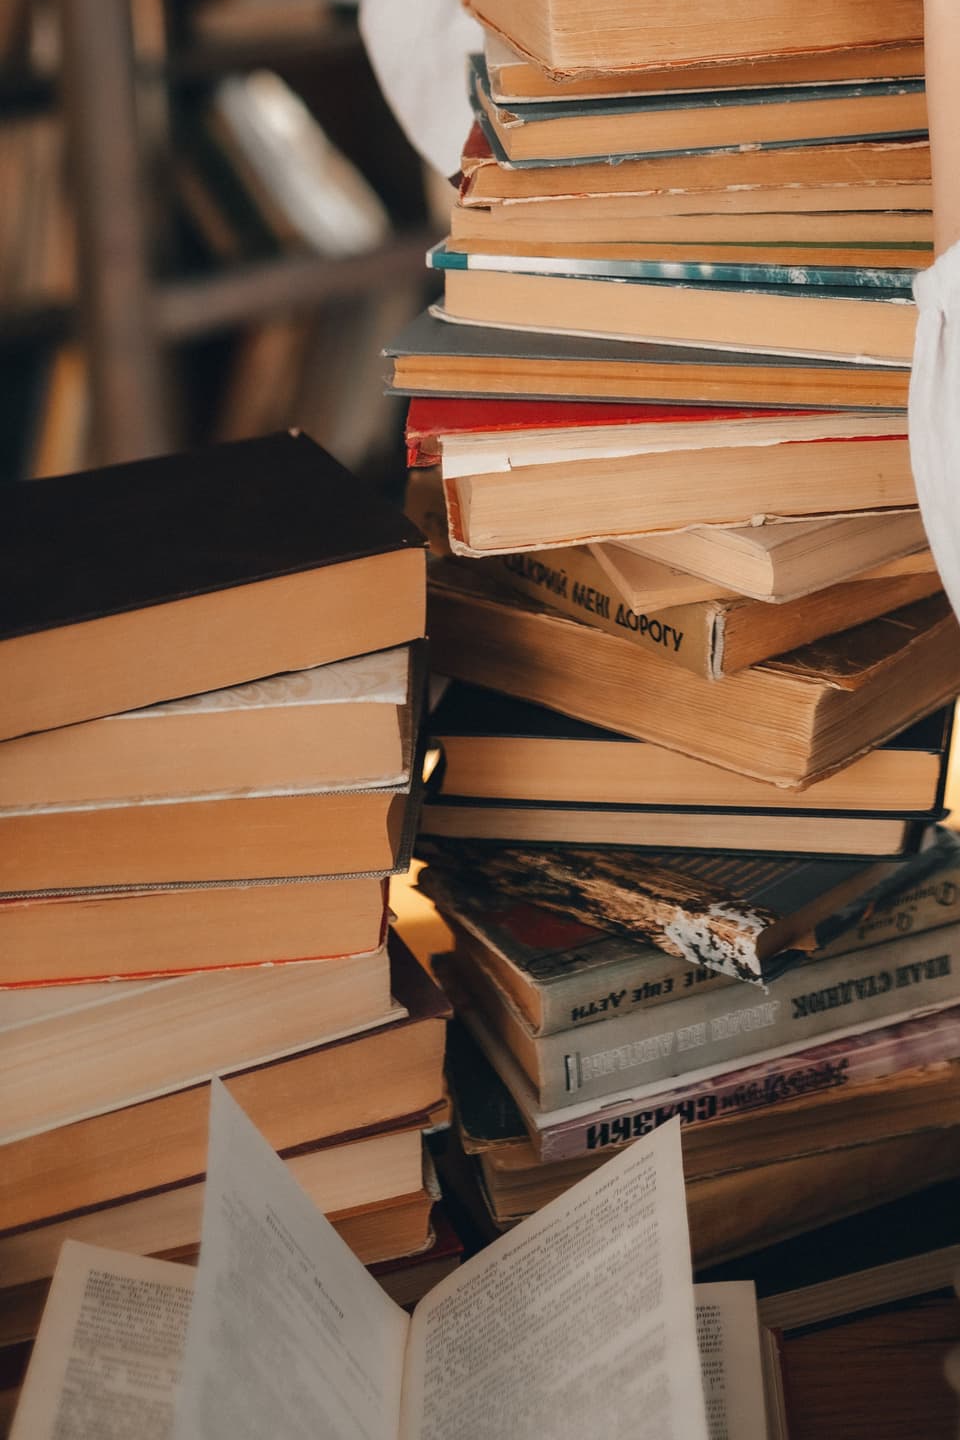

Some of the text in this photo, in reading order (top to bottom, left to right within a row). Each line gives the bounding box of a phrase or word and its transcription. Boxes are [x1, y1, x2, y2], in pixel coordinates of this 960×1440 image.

[572, 581, 610, 620] МЕНІ
[615, 603, 683, 652] ДОРОГУ
[630, 978, 674, 1004] ЕЩЕ
[893, 954, 952, 991] ИВАН
[571, 987, 628, 1022] ДЕТИ
[790, 972, 892, 1020] СТАДНЮК
[586, 1094, 718, 1150] СКАЗКИ
